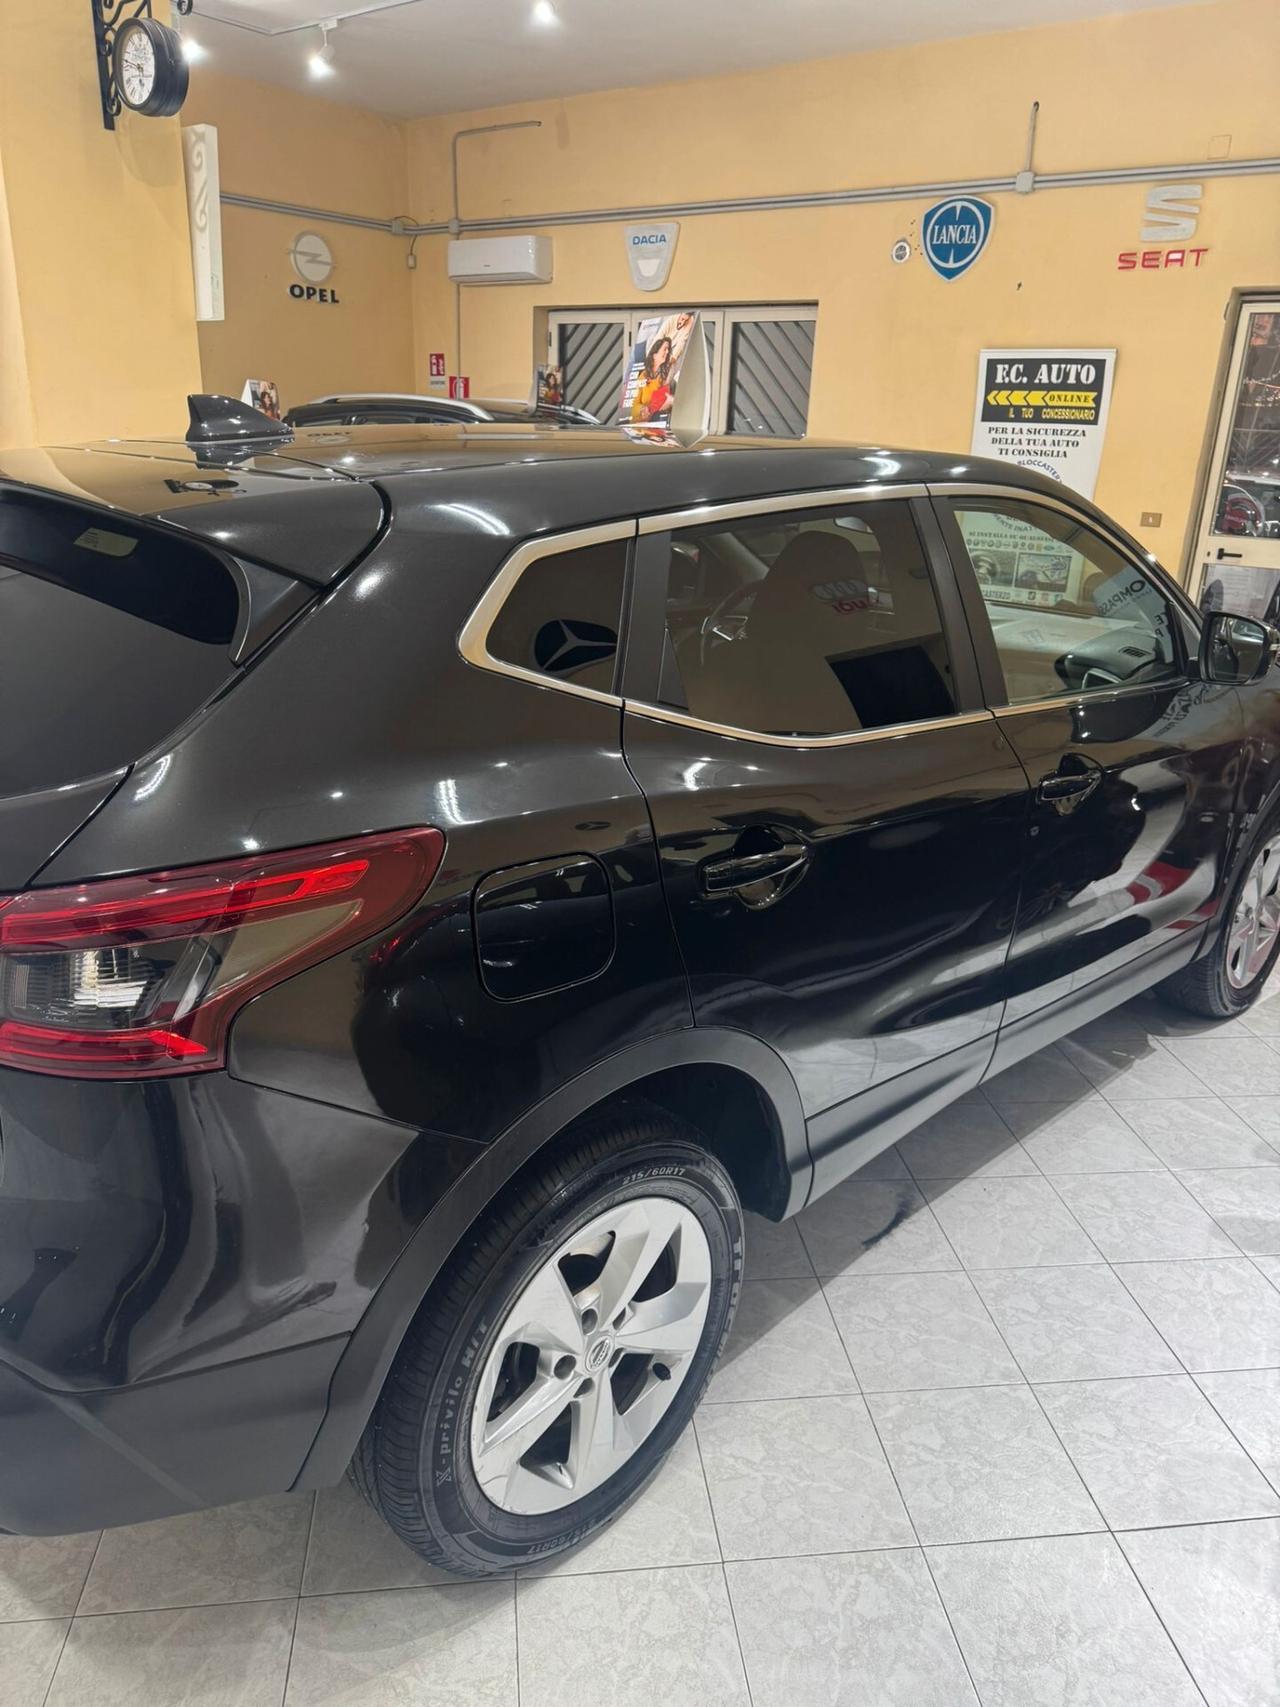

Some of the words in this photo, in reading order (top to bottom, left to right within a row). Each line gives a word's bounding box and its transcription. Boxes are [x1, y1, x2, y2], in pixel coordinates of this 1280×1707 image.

[632, 234, 667, 246] DACIA
[932, 224, 977, 245] LANCIA
[1117, 248, 1209, 270] SEAT
[289, 284, 340, 303] OPEL
[1033, 364, 1096, 385] AUTO
[1049, 394, 1091, 404] ONLINE
[1008, 407, 1015, 418] IL
[1021, 408, 1034, 419] TUO
[1041, 408, 1096, 421] CONCESSIONARIO
[988, 426, 1008, 435] PER
[1011, 427, 1023, 436] LA
[1025, 427, 1087, 438] SICUREZZA
[991, 437, 1023, 446] DELLA
[1026, 438, 1047, 448] TUA
[1049, 440, 1080, 449] AUTO
[999, 448, 1009, 456] TI
[1011, 448, 1068, 459] CONSIGLIA
[622, 1166, 687, 1186] 215/60R17
